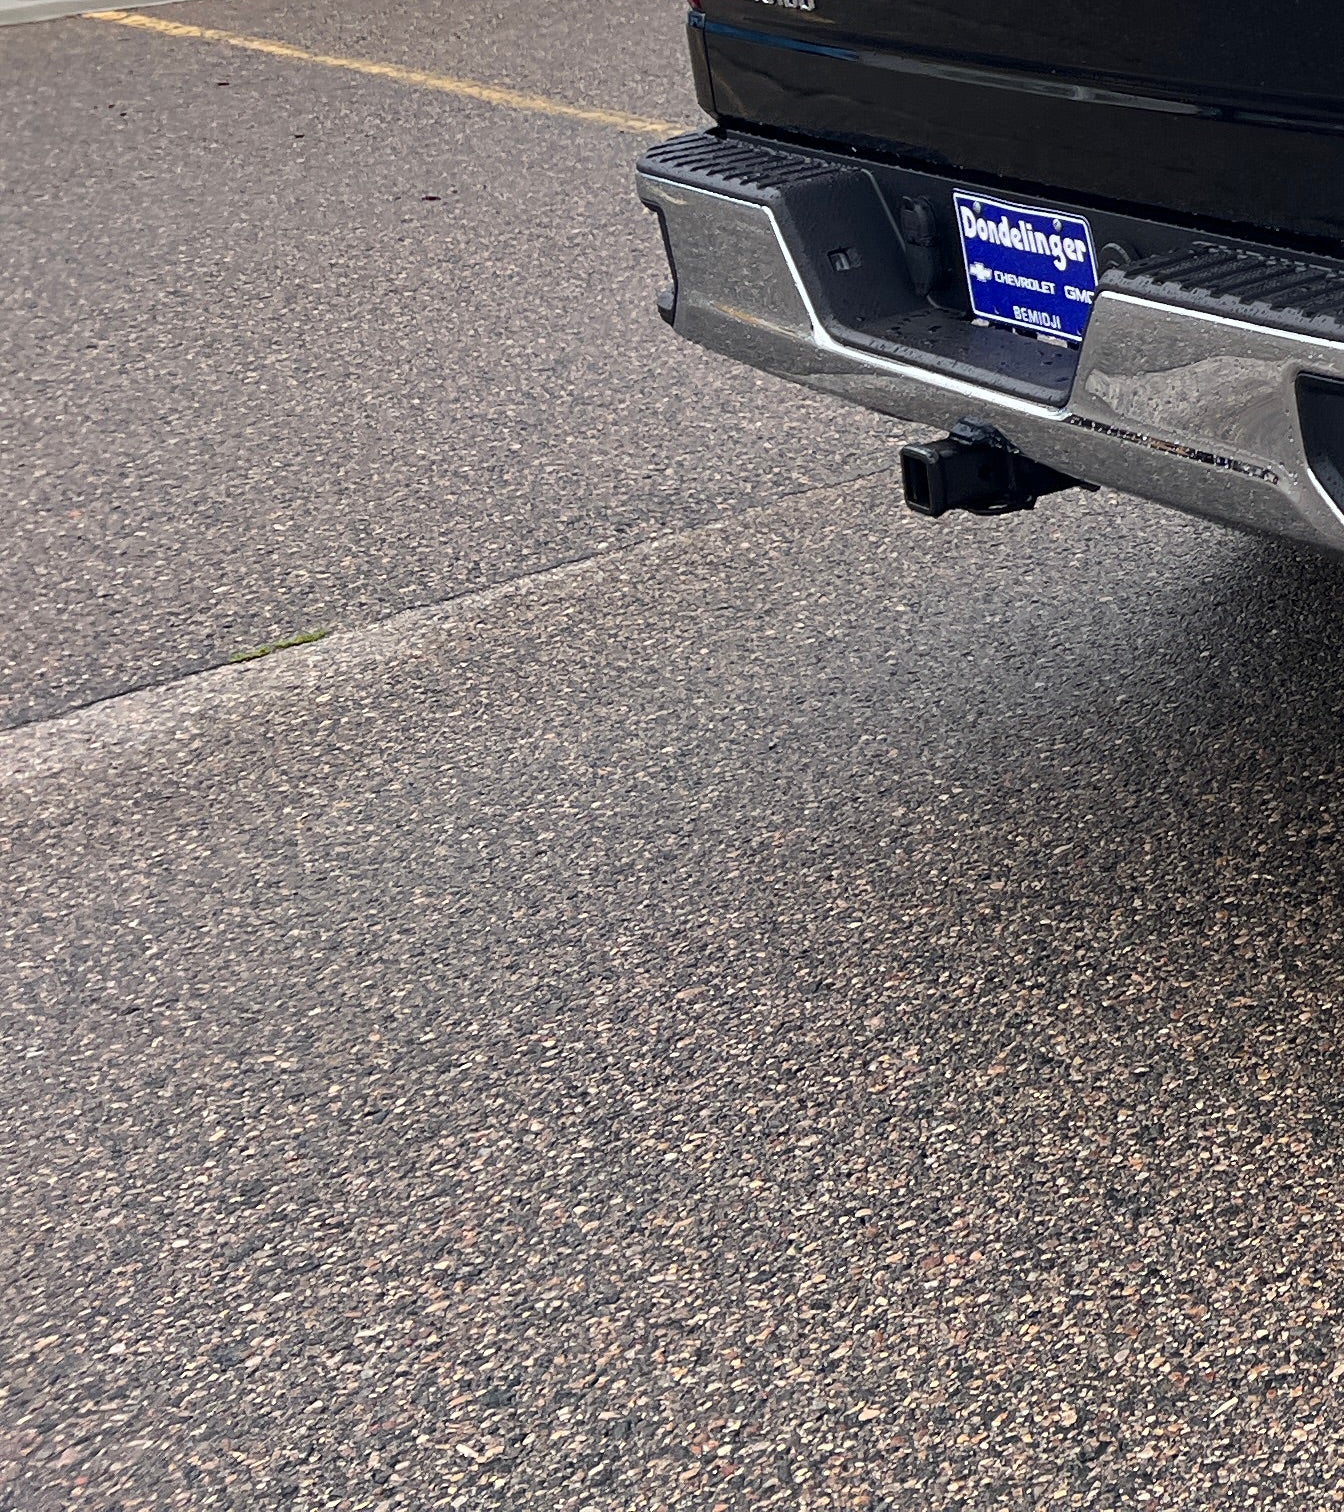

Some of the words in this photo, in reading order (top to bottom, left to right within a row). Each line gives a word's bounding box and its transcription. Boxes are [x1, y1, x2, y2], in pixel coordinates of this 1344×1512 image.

[959, 205, 1087, 272] Dondelinger
[993, 270, 1056, 295] CHEVROLET
[1063, 285, 1095, 305] GMC
[1012, 305, 1062, 330] BEMIDJI
